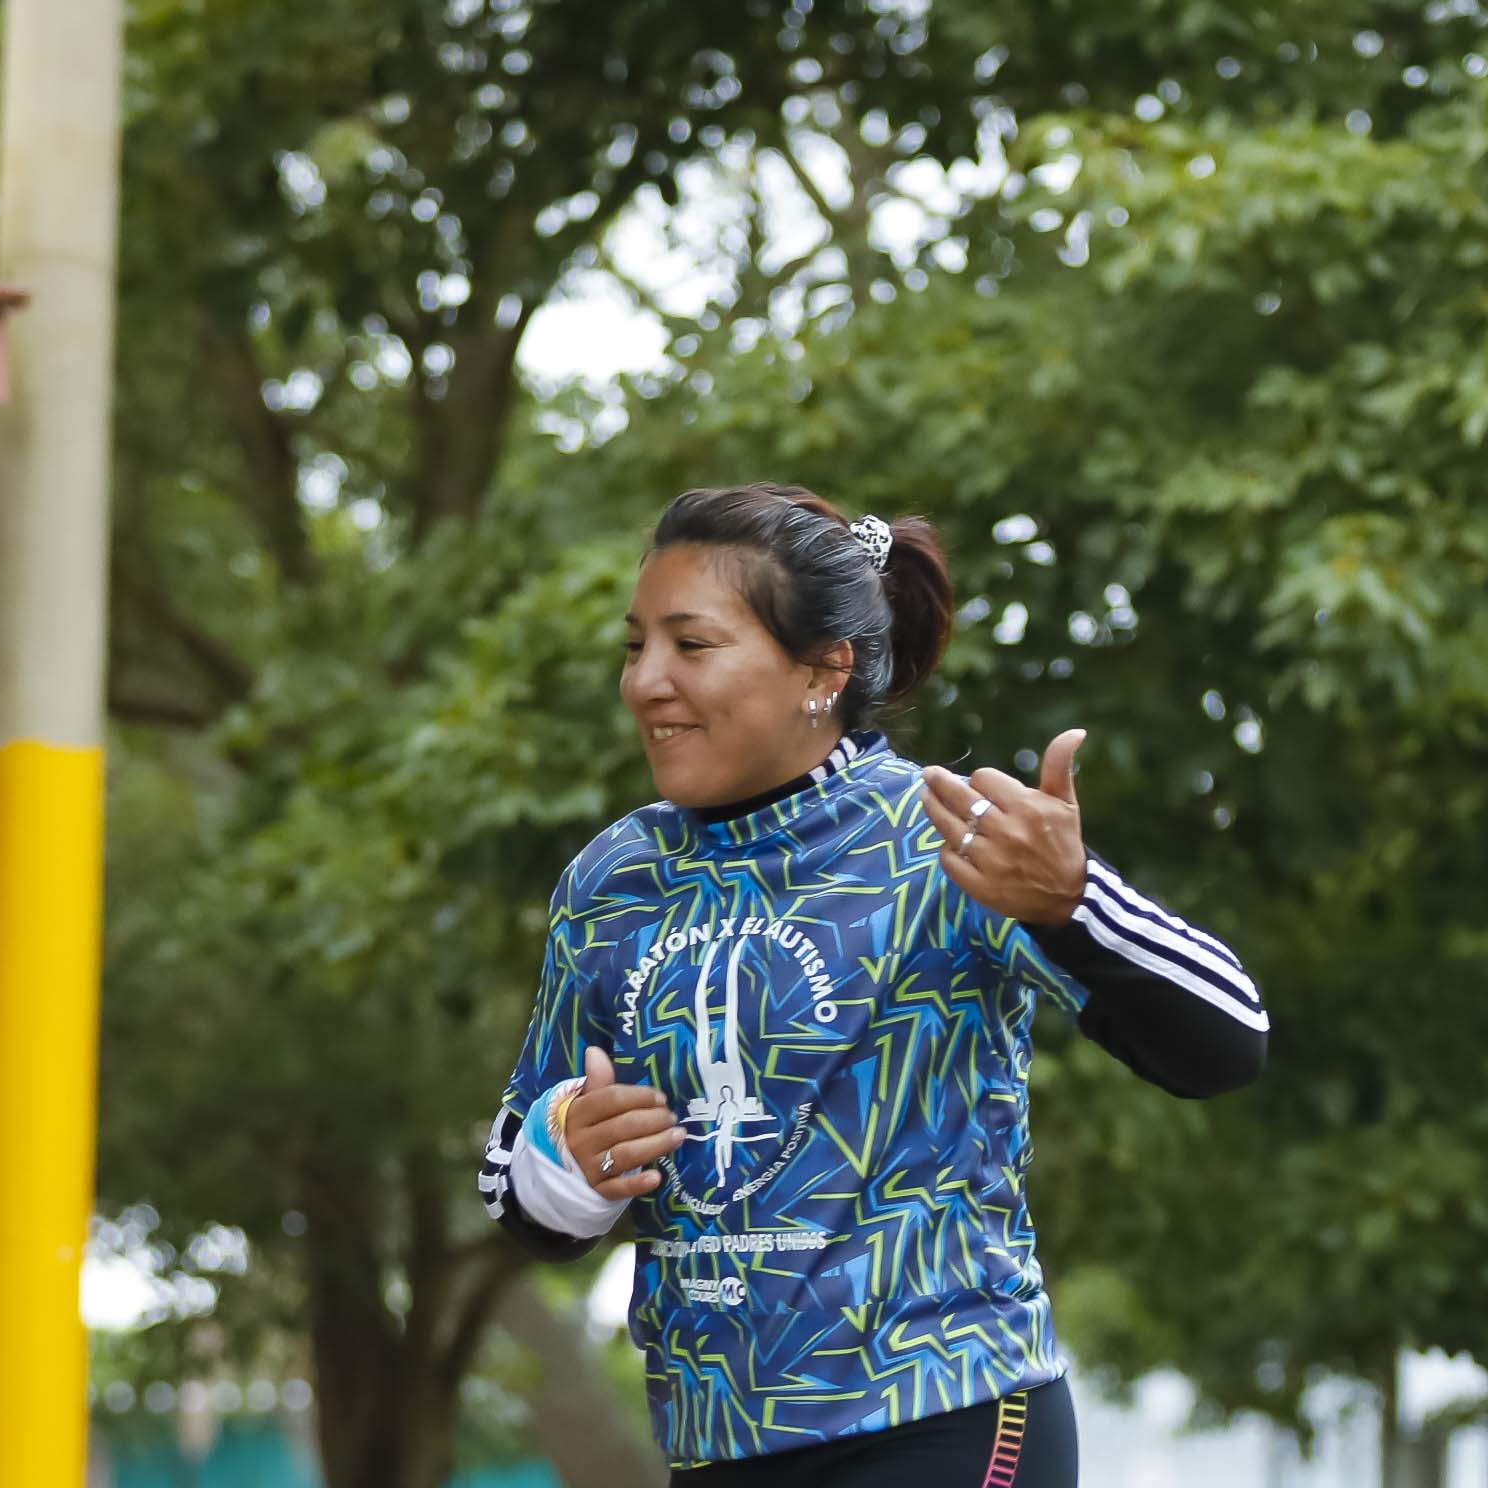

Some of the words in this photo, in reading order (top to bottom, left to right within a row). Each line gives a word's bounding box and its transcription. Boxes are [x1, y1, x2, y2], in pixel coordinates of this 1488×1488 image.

[621, 923, 712, 1036] MARATÓN
[715, 917, 738, 939] X
[738, 917, 767, 936] EL
[761, 919, 839, 1024] AUTISMO
[780, 1102, 814, 1160] POSITIVA
[722, 1233, 774, 1253] PADRES
